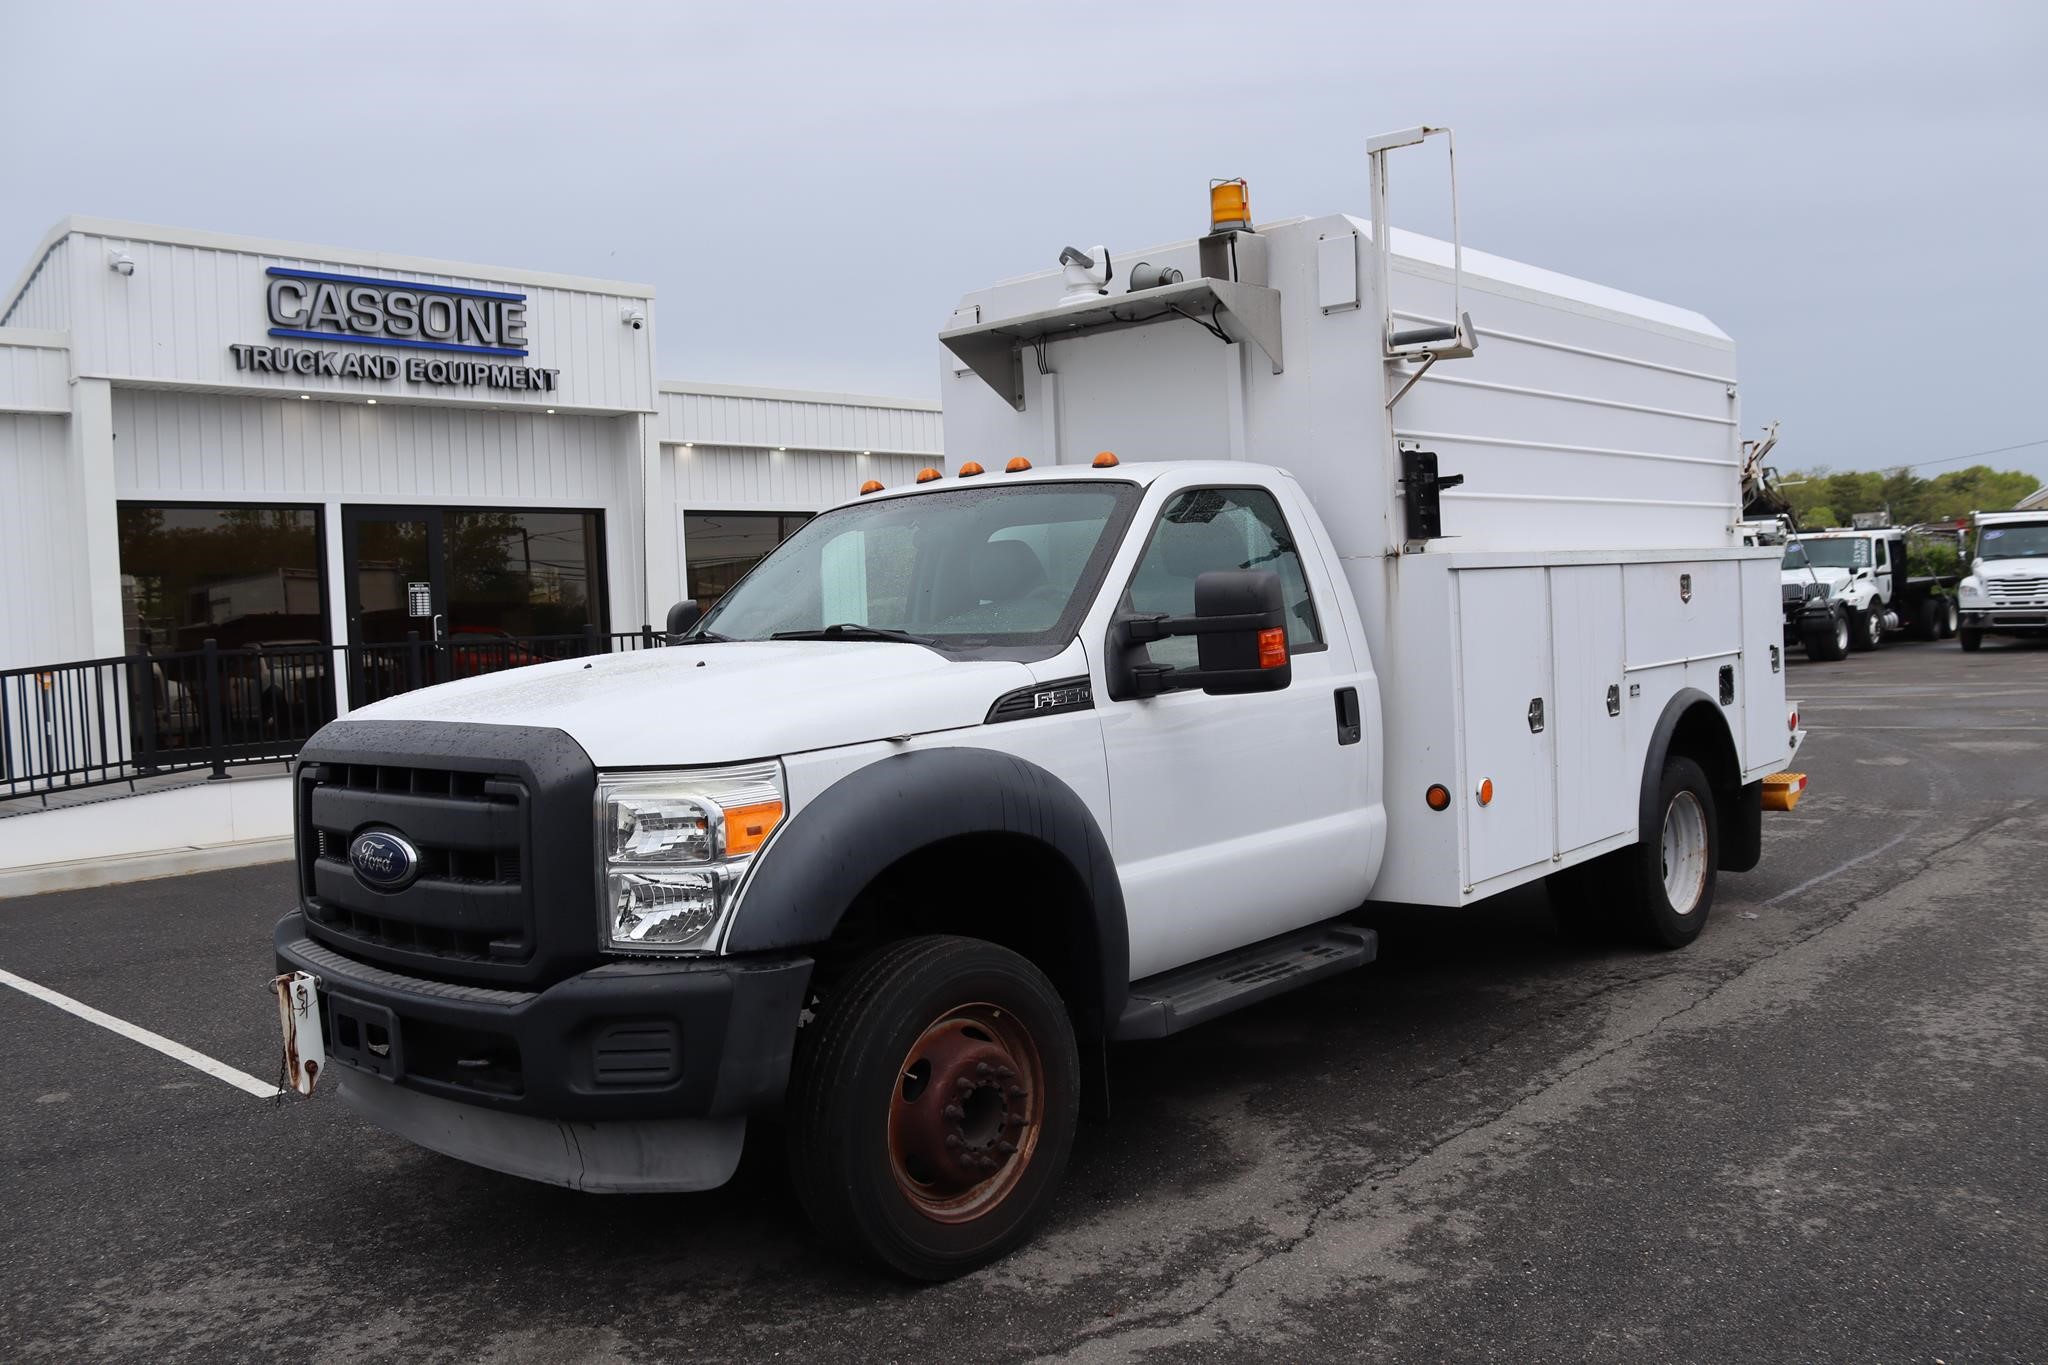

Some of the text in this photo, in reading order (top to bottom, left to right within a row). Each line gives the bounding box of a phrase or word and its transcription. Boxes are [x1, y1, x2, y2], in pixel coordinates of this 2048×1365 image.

[266, 278, 528, 346] CASSONE
[229, 343, 560, 391] TRUCK AND EQUIPMENT
[359, 840, 393, 872] Ford
